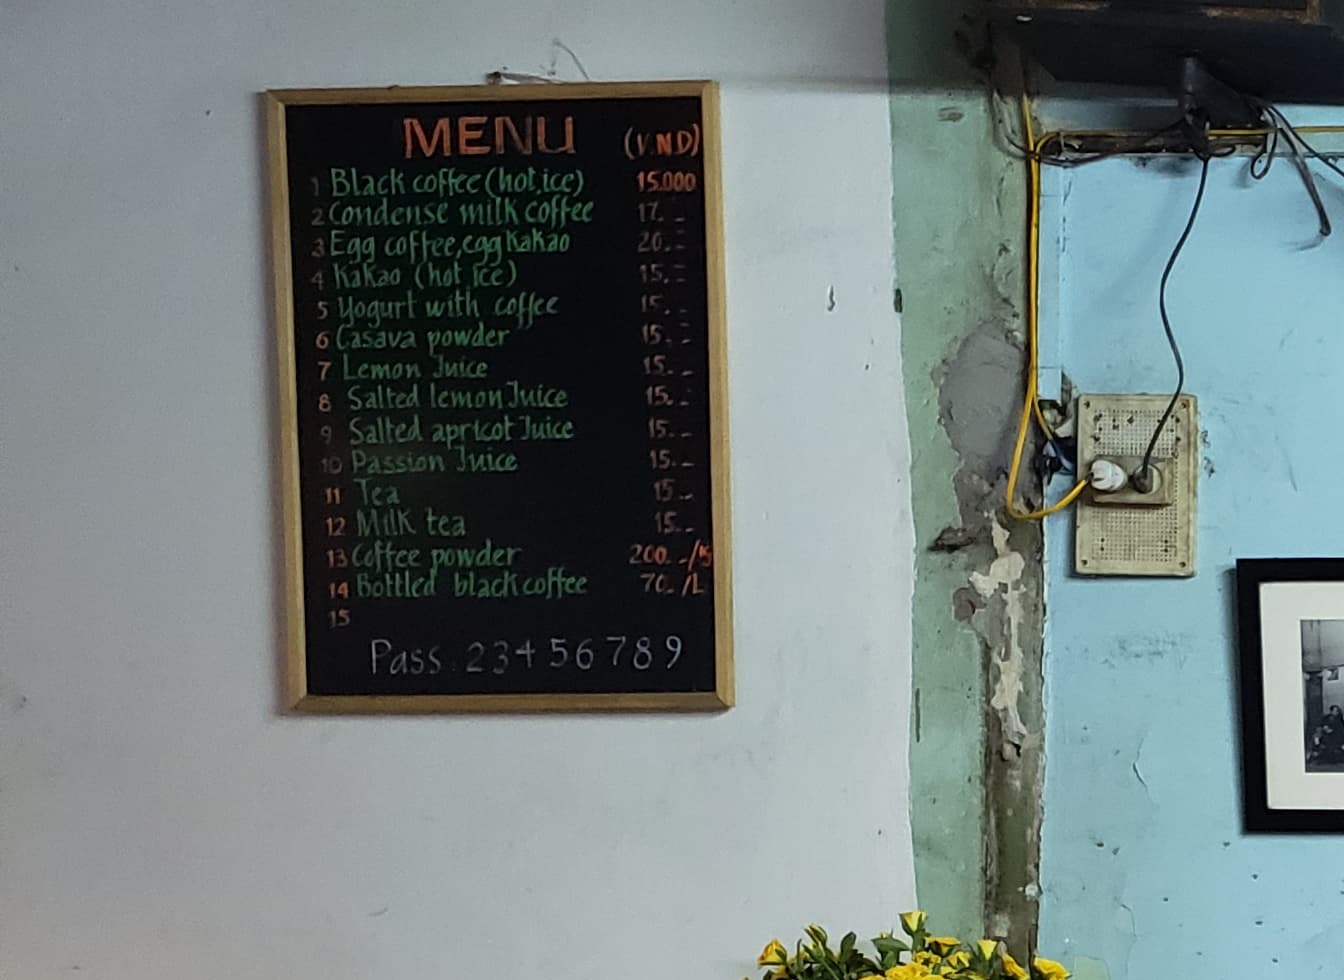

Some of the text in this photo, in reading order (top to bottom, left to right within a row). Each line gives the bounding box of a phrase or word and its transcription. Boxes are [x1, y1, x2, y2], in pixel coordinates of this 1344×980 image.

[402, 115, 576, 160] MENU
[310, 175, 321, 197] 1
[330, 167, 406, 198] Black
[636, 169, 698, 193] 15.000
[311, 207, 325, 227] 2
[328, 197, 449, 226] Condense
[459, 197, 519, 226] milk
[525, 195, 595, 229] coffee
[311, 237, 325, 258] 3
[330, 229, 376, 264] Egg
[311, 271, 324, 291] 4
[317, 301, 329, 320] 5
[338, 289, 416, 328] Yogurt
[425, 286, 480, 318] with
[494, 290, 559, 329] coffee
[315, 331, 330, 350] 6
[336, 323, 417, 350] Casava
[427, 321, 511, 356] powder
[317, 361, 333, 382] 7
[342, 353, 422, 380] Lemon
[432, 351, 489, 379] Juice
[318, 393, 332, 413] 8
[348, 384, 420, 411] Salted
[429, 381, 502, 409] lemon
[506, 379, 569, 409] Juice
[320, 425, 333, 445] 9
[350, 413, 423, 445] Salted
[431, 414, 514, 450] apricot
[519, 414, 576, 441] Juice
[320, 456, 343, 475] 10
[351, 449, 446, 475] Passion
[455, 446, 518, 473] Juice
[325, 487, 342, 505] 11
[352, 477, 400, 506] Tea
[325, 516, 347, 537] 12
[356, 508, 417, 537] Milk
[425, 506, 467, 537] tea
[326, 549, 348, 569] 13
[352, 539, 422, 574] Coffee
[430, 537, 522, 577] powder
[329, 581, 351, 600] 14
[356, 569, 436, 599] Bottled
[454, 569, 518, 599] black
[522, 566, 588, 600] coffee
[329, 608, 351, 630] 15
